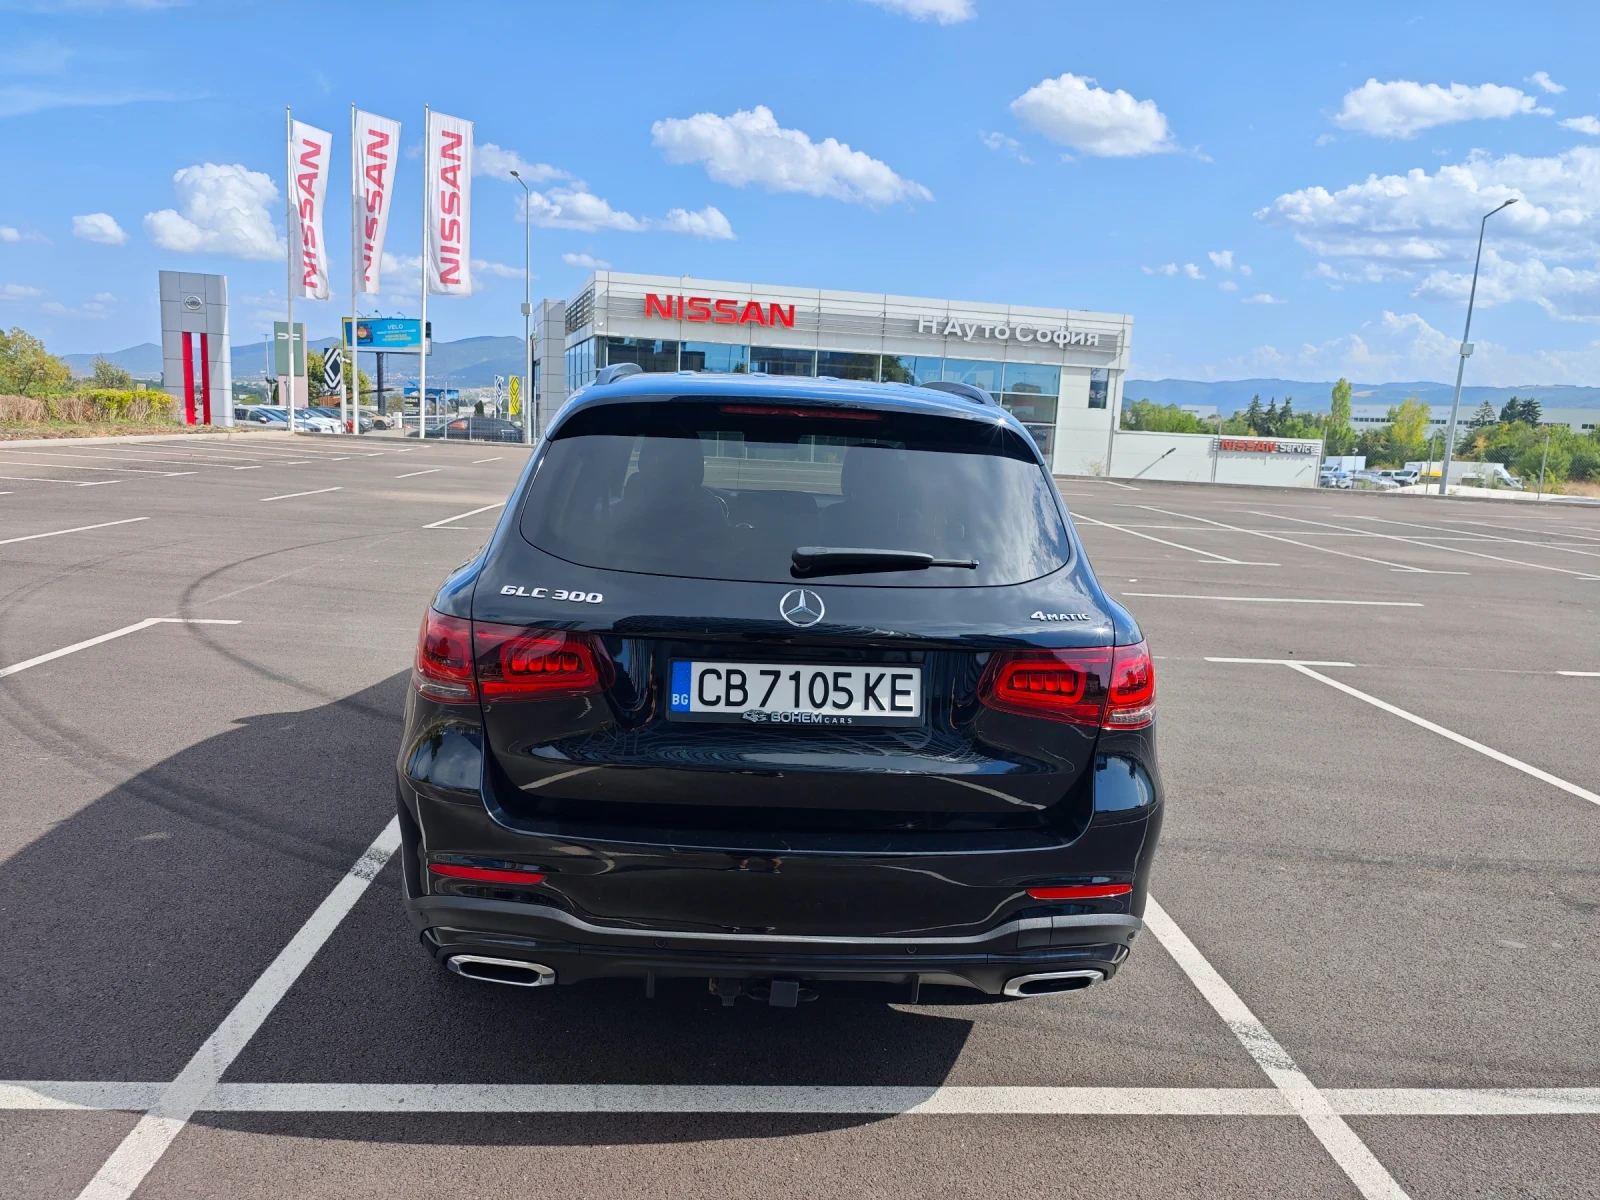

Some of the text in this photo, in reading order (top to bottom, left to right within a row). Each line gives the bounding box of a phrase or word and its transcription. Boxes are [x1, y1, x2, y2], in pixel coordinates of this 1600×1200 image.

[297, 138, 322, 289] NISSAN
[364, 128, 390, 282] NISSAN
[440, 130, 463, 285] NISSAN
[645, 293, 796, 329] NISSAN
[1015, 323, 1100, 349] София
[1221, 440, 1317, 454] NISSAN Service
[500, 585, 603, 604] GLC 300
[1030, 610, 1092, 621] 4MATIC
[672, 693, 689, 706] BG
[770, 711, 823, 724] BOHEM
